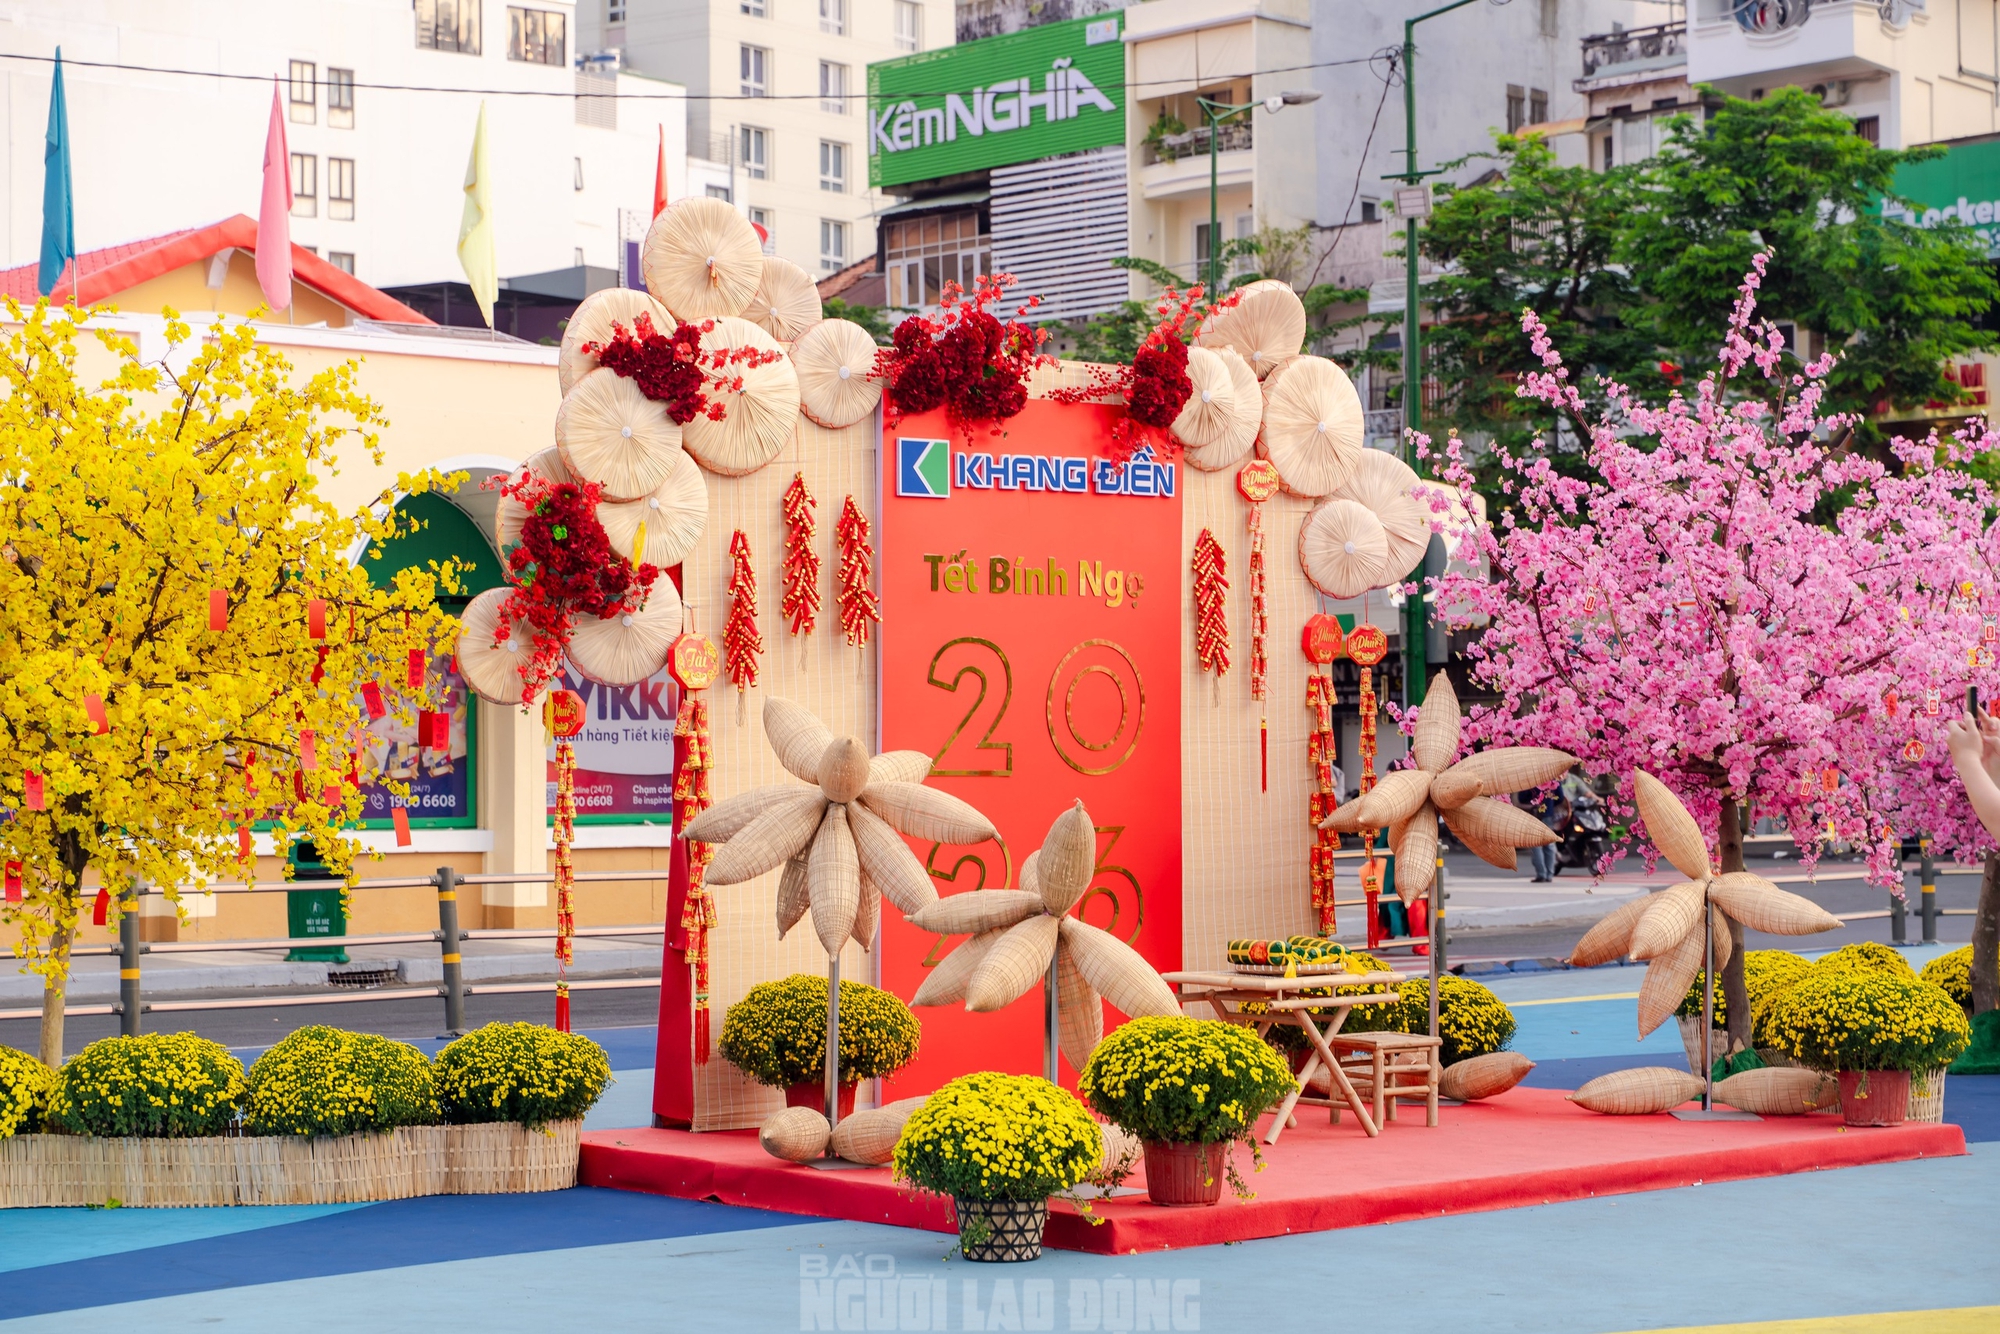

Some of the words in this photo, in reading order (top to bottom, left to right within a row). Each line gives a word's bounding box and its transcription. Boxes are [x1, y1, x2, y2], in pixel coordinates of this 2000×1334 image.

[955, 451, 1088, 493] KHANG
[1093, 444, 1175, 497] ĐIỀN
[923, 549, 980, 594] Tết
[989, 554, 1069, 596] Bính
[1079, 559, 1145, 609] Ngọ
[928, 637, 1145, 776] 20
[587, 727, 619, 744] hàng
[623, 726, 648, 741] Tiết
[423, 795, 456, 807] 6608
[587, 796, 613, 807] 6608
